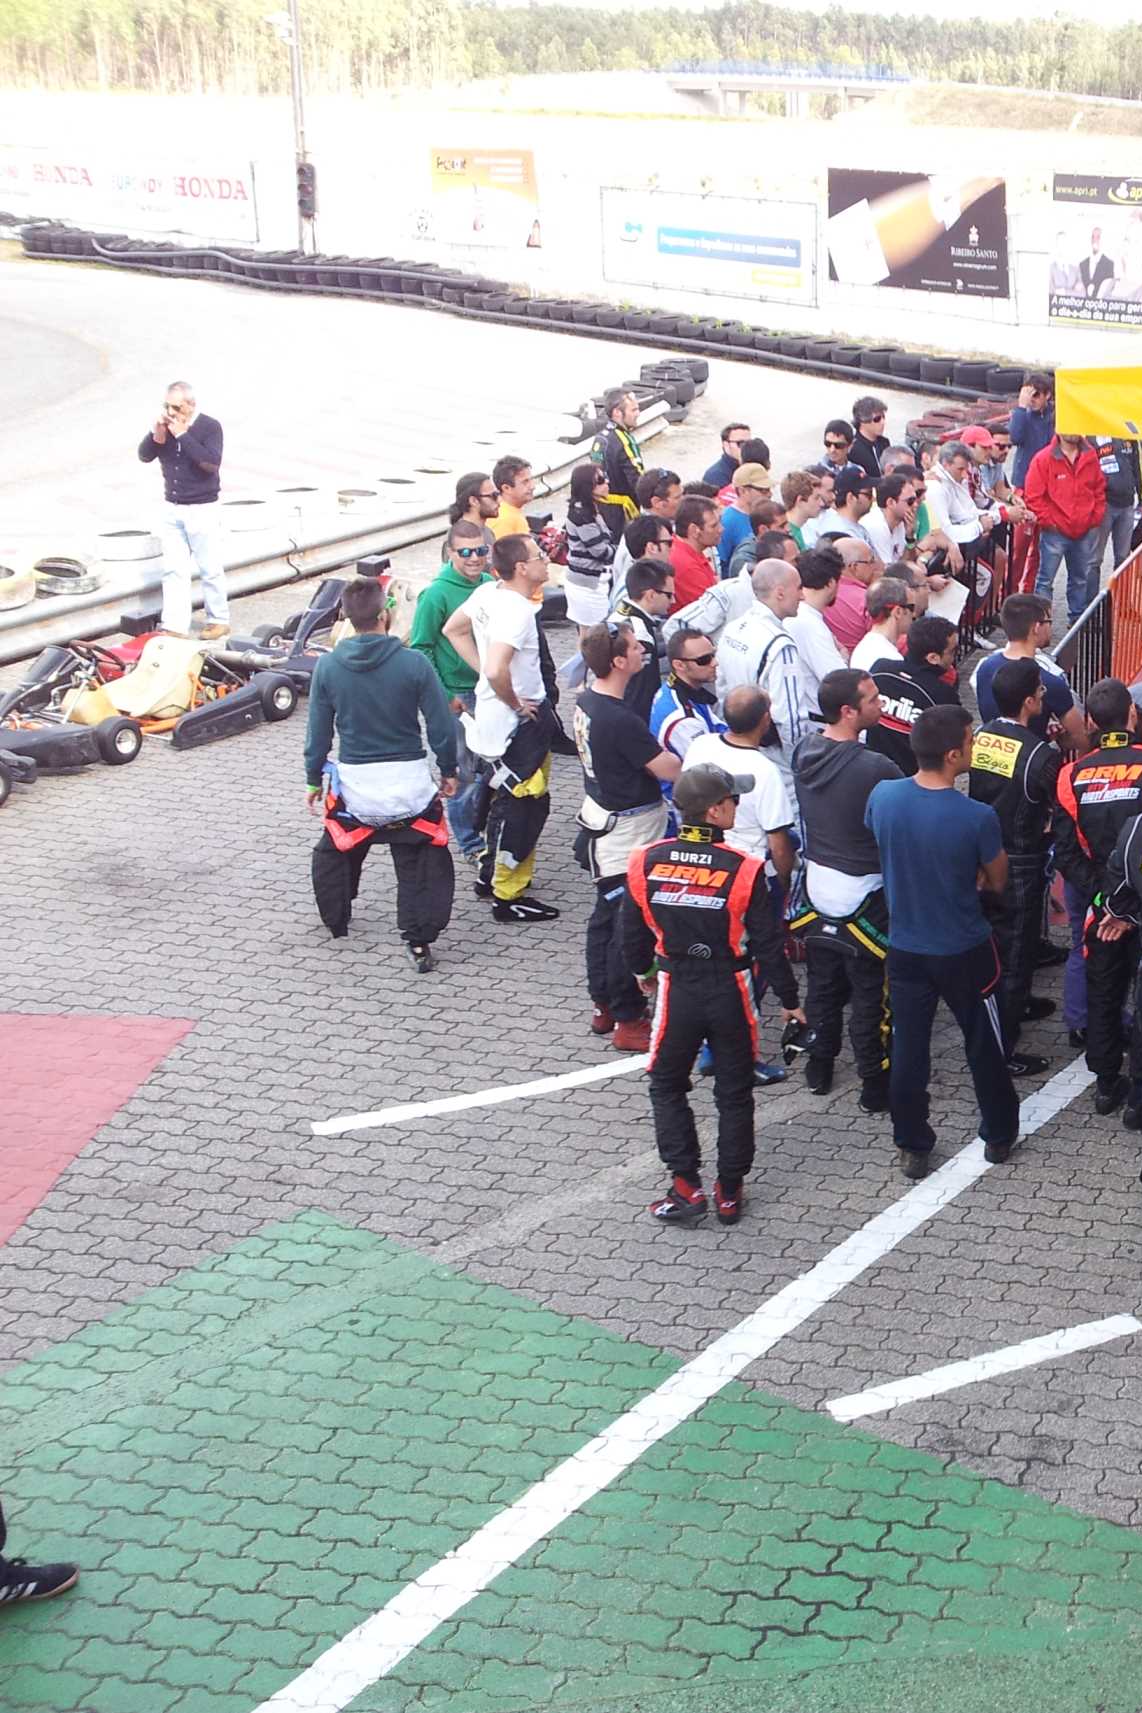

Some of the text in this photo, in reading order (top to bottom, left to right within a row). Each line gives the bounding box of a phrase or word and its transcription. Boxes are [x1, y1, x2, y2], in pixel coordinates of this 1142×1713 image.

[175, 176, 249, 200] HONDA
[1055, 185, 1097, 198] www.apri.pt
[950, 246, 998, 259] RIBEIRO SANTO
[1051, 295, 1057, 305] A
[1059, 297, 1084, 307] melhor
[1085, 299, 1107, 310] opção
[1108, 301, 1126, 312] para
[1051, 307, 1057, 315] o
[1093, 311, 1103, 320] da
[1104, 312, 1119, 321] sua
[878, 694, 924, 724] prilia
[976, 735, 1016, 754] GAS
[670, 850, 713, 865] BURZI
[649, 863, 729, 888] BRM
